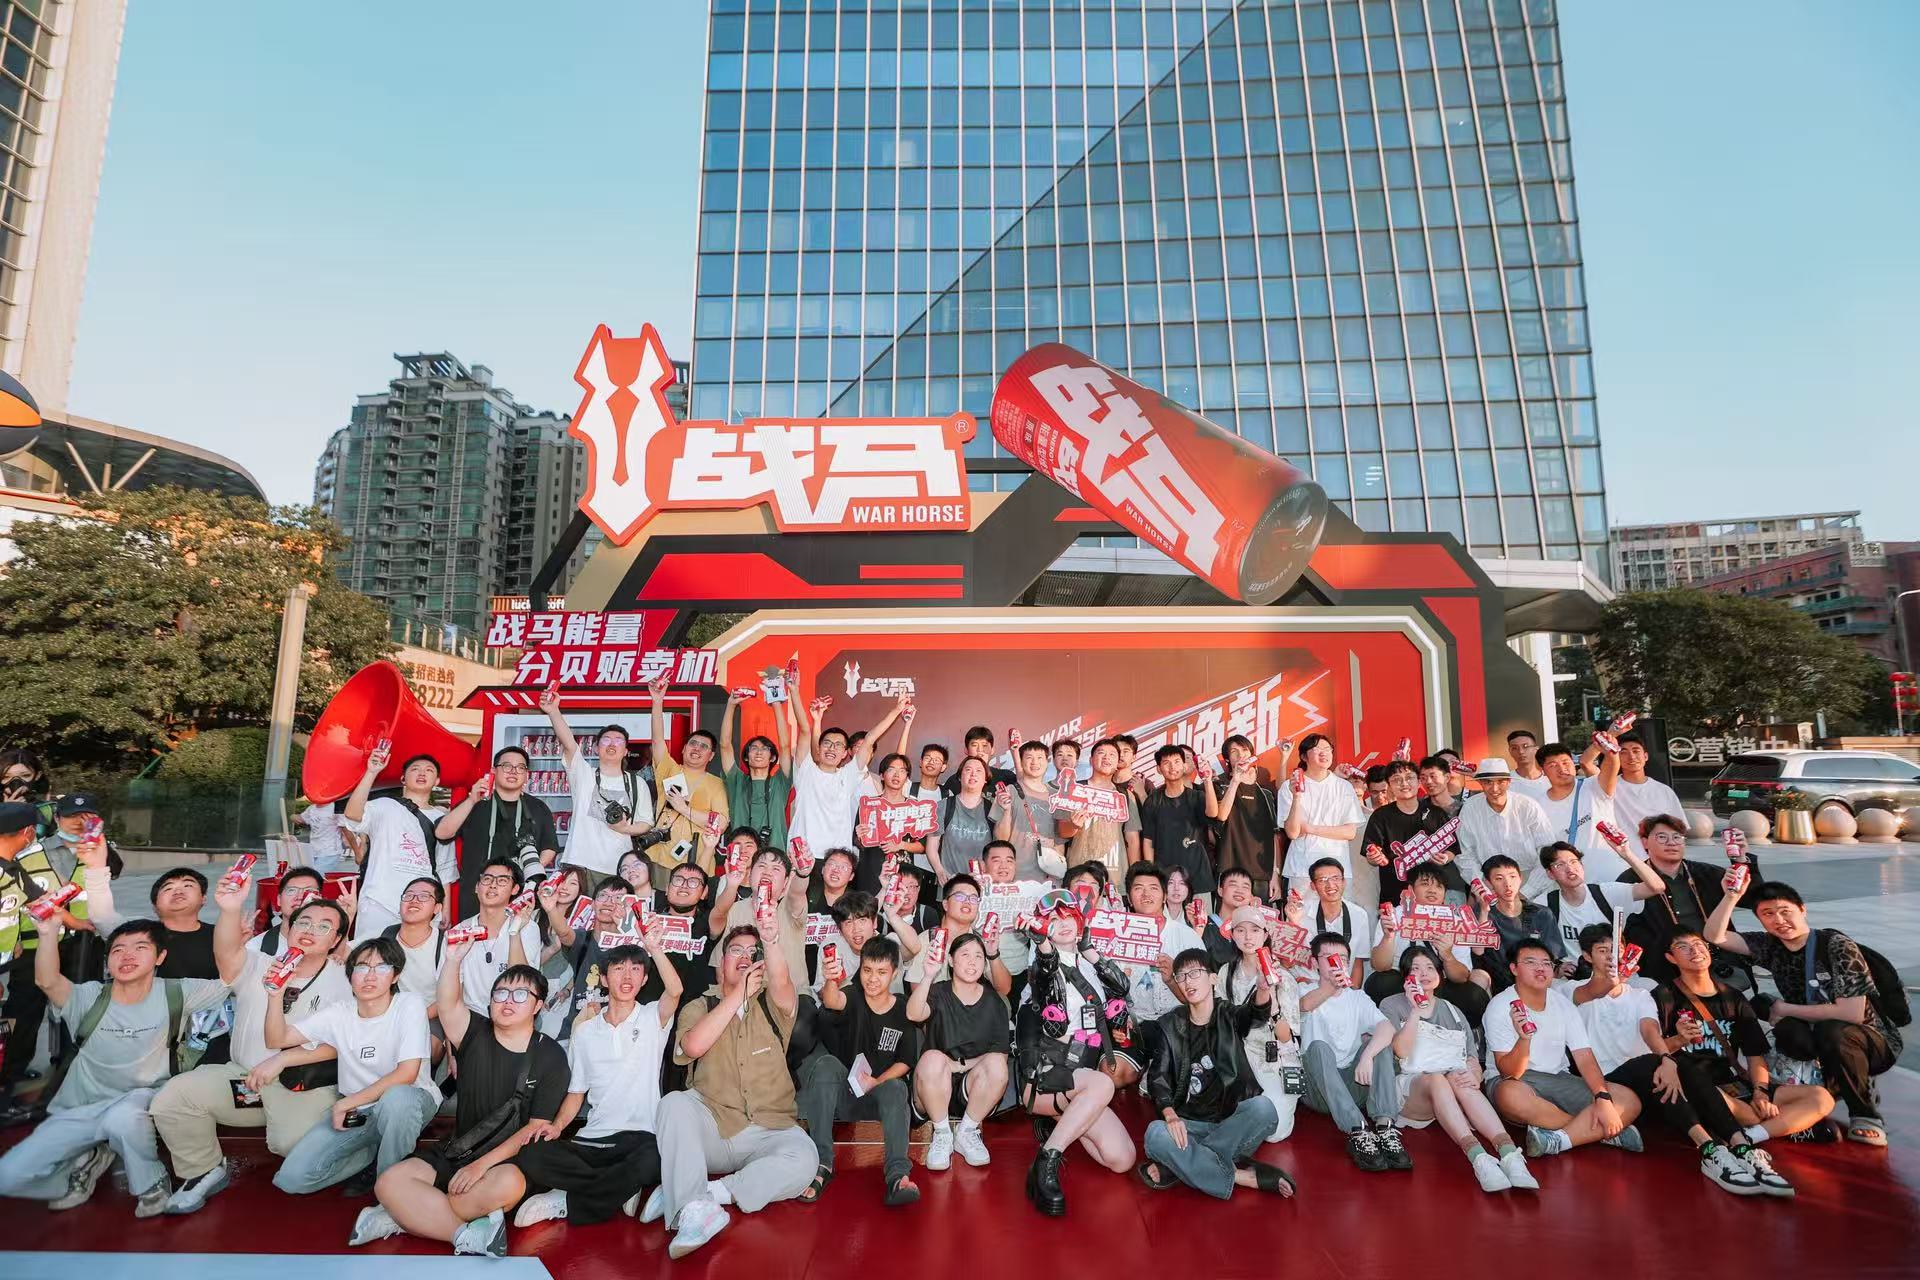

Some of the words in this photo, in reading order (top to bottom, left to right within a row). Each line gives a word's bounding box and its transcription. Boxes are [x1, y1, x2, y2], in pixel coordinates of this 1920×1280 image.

[1049, 429, 1059, 464] ENERGY
[668, 424, 961, 524] 战马
[1028, 364, 1225, 577] 战马
[852, 506, 896, 523] WAR
[902, 505, 964, 523] HORSE
[1125, 503, 1144, 526] WAR
[1145, 523, 1175, 552] HORSE
[487, 613, 642, 646] 战马能量
[515, 651, 717, 684] 分贝贩卖机
[861, 678, 915, 697] 战马
[1040, 716, 1082, 748] WAR
[881, 803, 934, 829] 中国电竞
[1091, 911, 1158, 938] 战马
